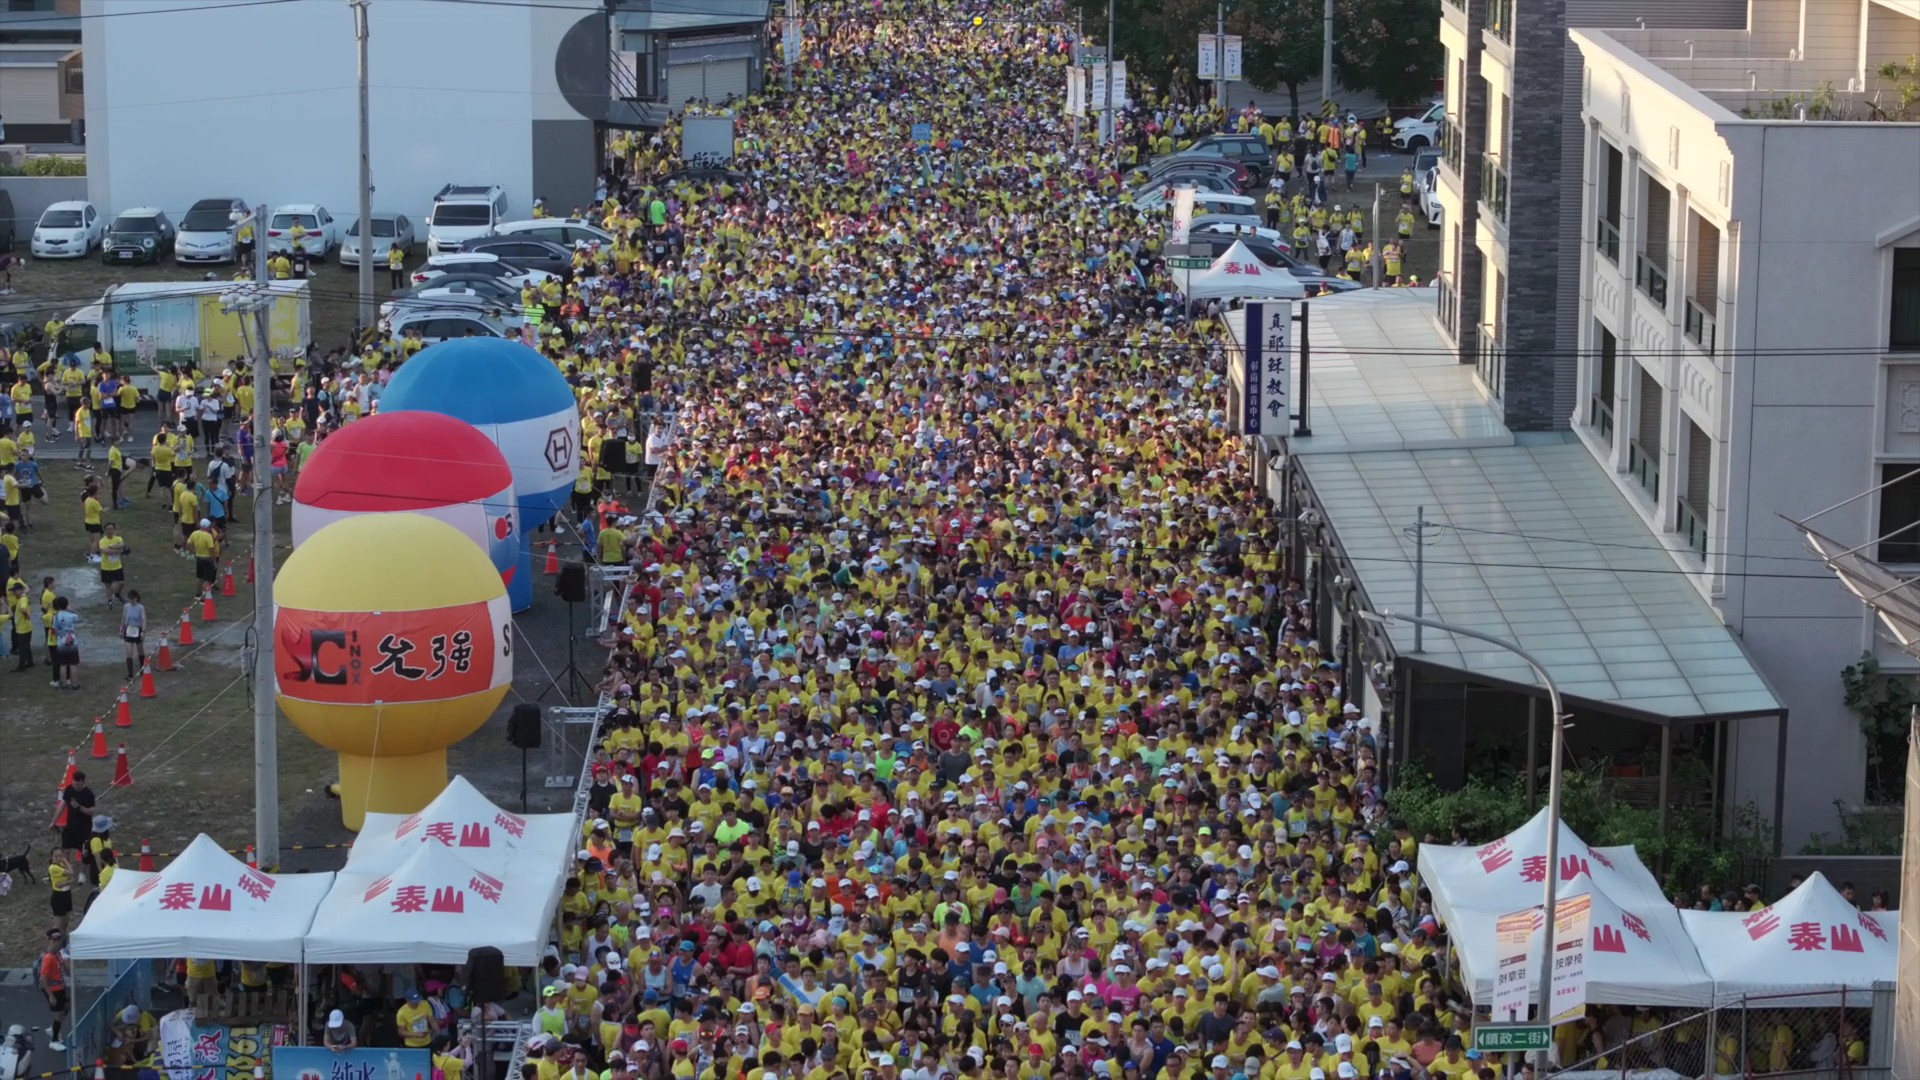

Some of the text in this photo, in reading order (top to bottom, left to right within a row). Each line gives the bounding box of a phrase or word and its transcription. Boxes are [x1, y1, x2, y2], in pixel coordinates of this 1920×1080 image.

[1224, 261, 1261, 276] 泰山
[1267, 313, 1285, 418] 真耶穌教會
[159, 882, 232, 911] 泰山
[390, 885, 464, 913] 泰山
[1787, 921, 1865, 953] 泰山
[1485, 1031, 1541, 1045] 鎮政二街
